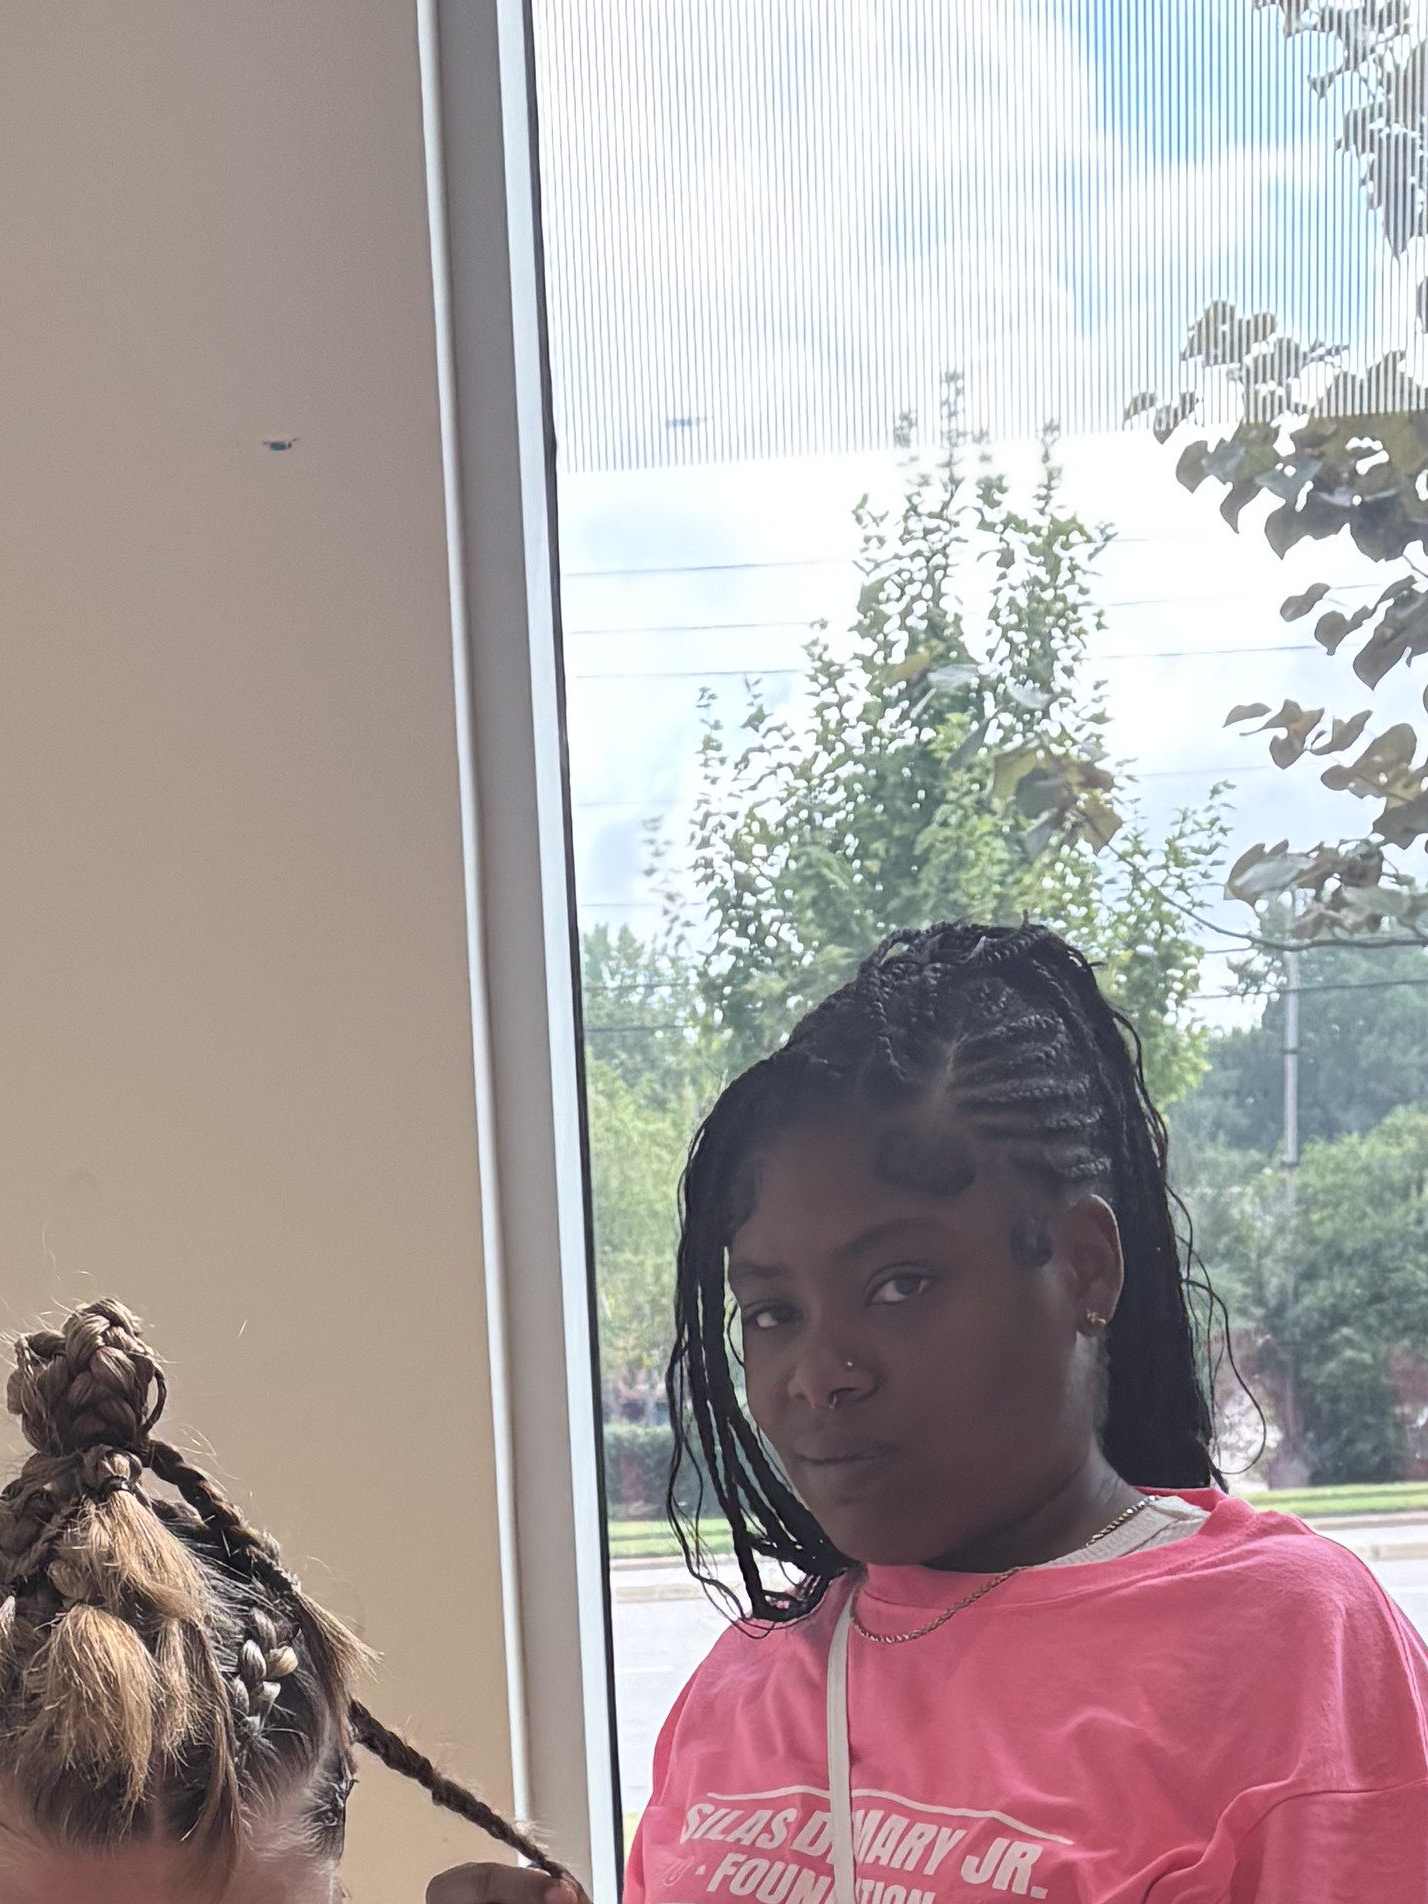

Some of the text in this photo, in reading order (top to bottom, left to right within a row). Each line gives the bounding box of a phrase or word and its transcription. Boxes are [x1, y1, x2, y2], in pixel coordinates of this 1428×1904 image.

[680, 1802, 1049, 1900] SILAS DMARY JR.
